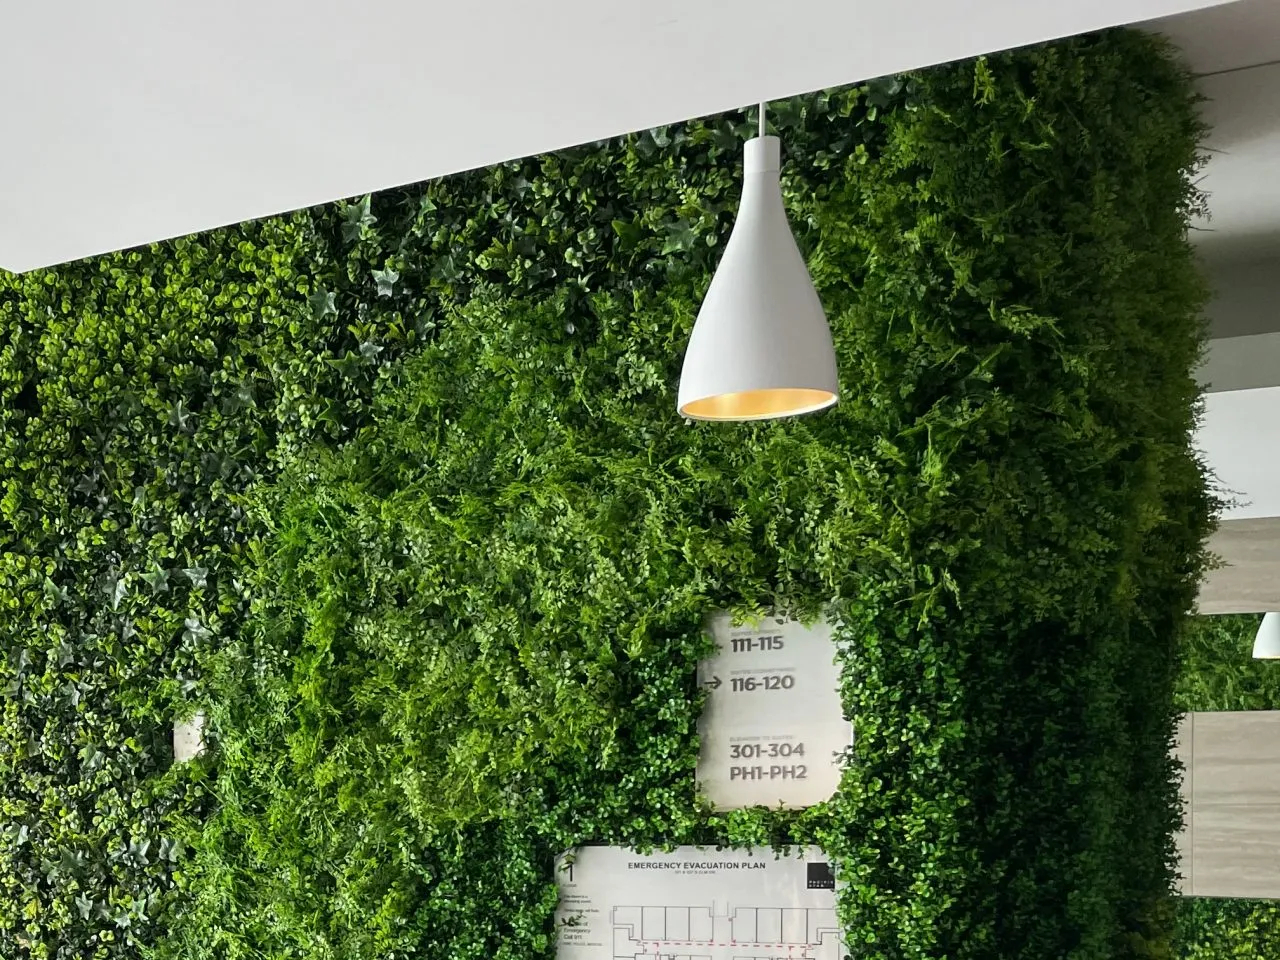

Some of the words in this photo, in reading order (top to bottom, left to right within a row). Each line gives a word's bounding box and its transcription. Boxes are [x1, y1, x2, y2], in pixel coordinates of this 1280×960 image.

[731, 636, 784, 652] 111-115
[730, 675, 795, 692] 116-120
[730, 743, 805, 758] 301-304
[730, 765, 807, 780] PH1-PH2
